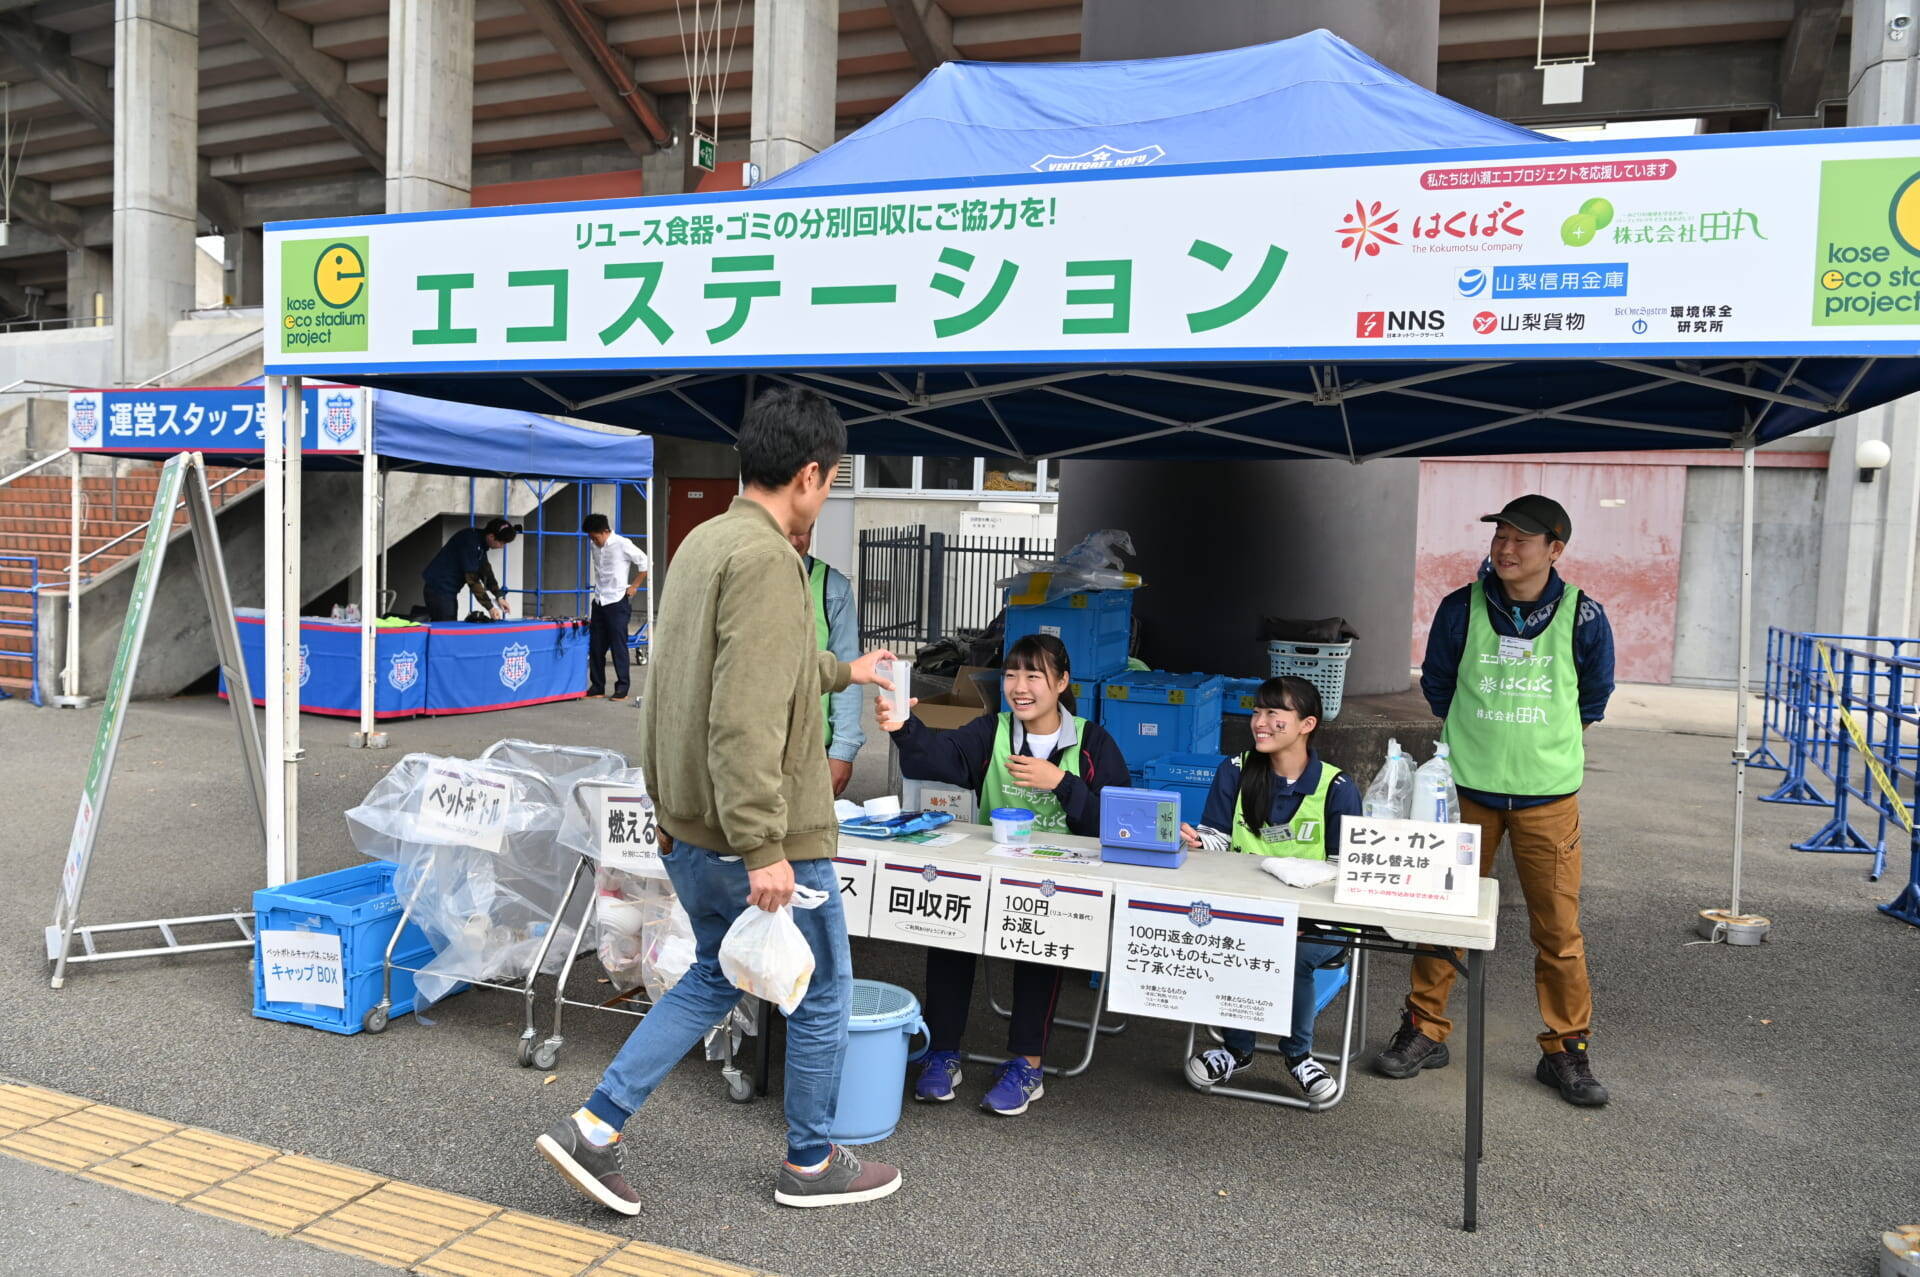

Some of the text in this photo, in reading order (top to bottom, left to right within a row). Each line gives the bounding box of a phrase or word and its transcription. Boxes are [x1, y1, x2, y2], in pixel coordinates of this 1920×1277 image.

[1115, 154, 1147, 167] KOFU
[1427, 163, 1669, 187] 私たちは小瀬エコプロジェクトを応援しています
[1412, 201, 1525, 239] はくばく
[1412, 242, 1523, 253] The Kokumotsu Company
[1828, 242, 1890, 263] kose
[1496, 271, 1624, 292] 山梨信用金庫
[1821, 269, 1881, 290] eco
[412, 238, 1289, 346] エコステーション
[287, 297, 315, 310] kose
[1670, 305, 1732, 318] 環境保全
[1825, 291, 1920, 317] project
[284, 312, 365, 329] eco stadium
[1388, 310, 1445, 331] NNS
[1501, 313, 1585, 331] 山梨貨物
[1677, 320, 1723, 333] 研究所
[287, 329, 331, 347] project
[109, 401, 308, 441] 運営スタッフ
[608, 809, 657, 845] 燃える
[1350, 827, 1445, 850] ビン・カン
[1348, 852, 1430, 869] の移し替えは
[888, 886, 972, 924] 回収所
[1005, 895, 1049, 916] 100円
[1002, 915, 1045, 936] お返し
[1000, 937, 1074, 960] いたします
[1129, 925, 1246, 952] 100円返金の対象と
[1127, 941, 1280, 974] ならないものもございます。
[272, 963, 338, 985] キャップ BOX
[1126, 958, 1214, 982] ご了承ください。
